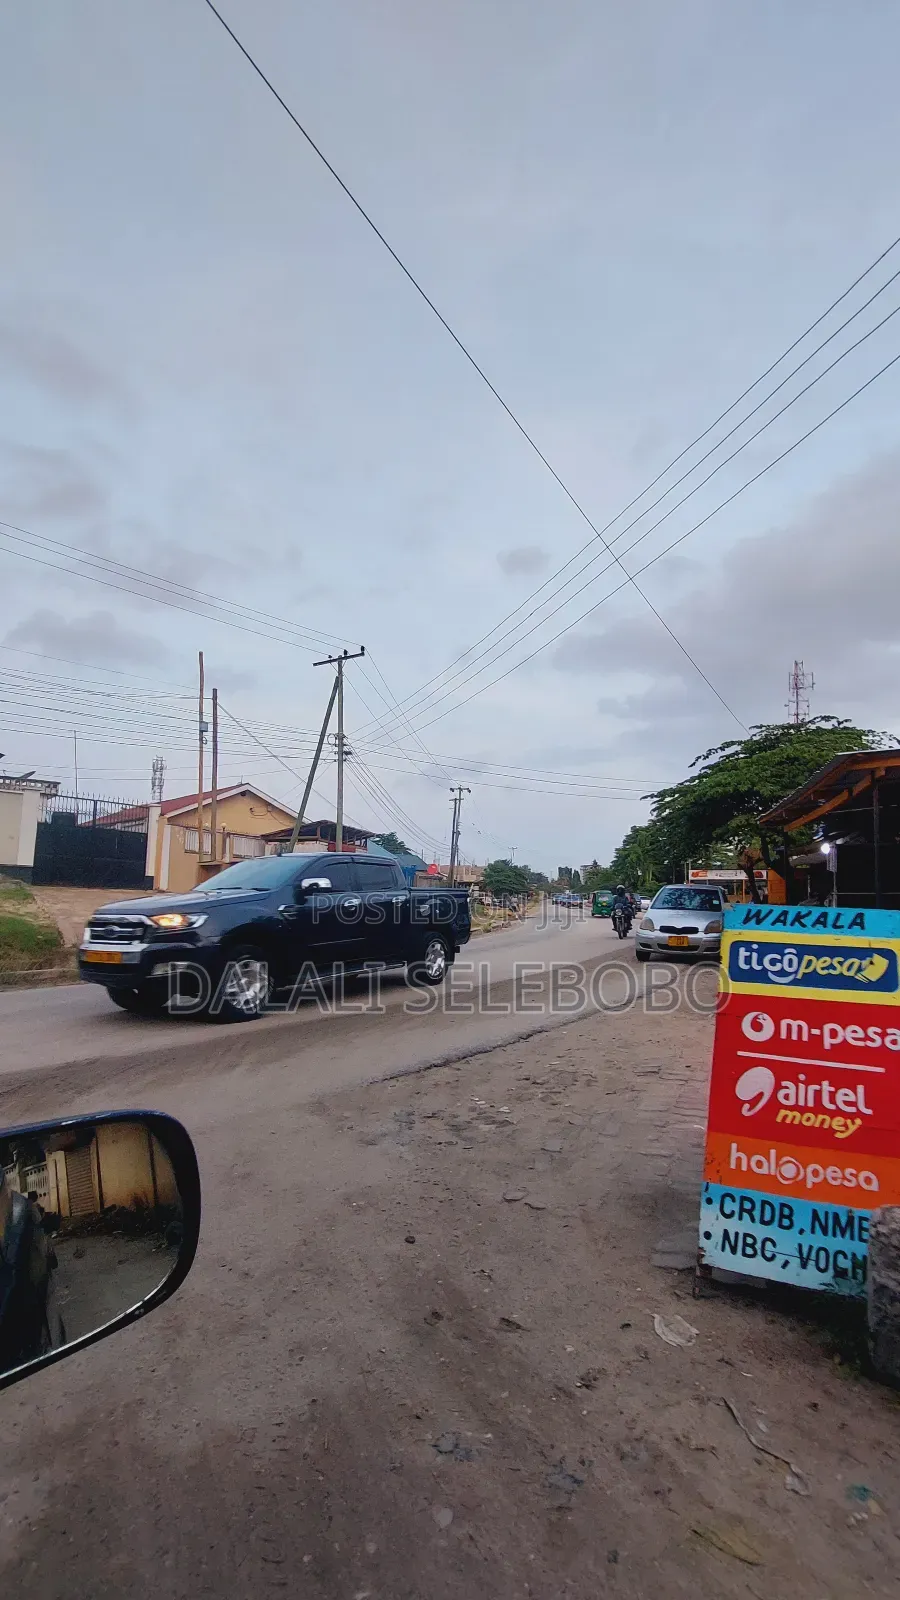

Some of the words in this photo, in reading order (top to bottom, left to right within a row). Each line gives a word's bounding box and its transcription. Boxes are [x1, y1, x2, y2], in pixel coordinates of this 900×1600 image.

[742, 908, 866, 930] WAKALA
[780, 1018, 900, 1051] m-pesa
[776, 1073, 873, 1115] airtel
[775, 1108, 862, 1139] money
[730, 1142, 880, 1192] halopesa
